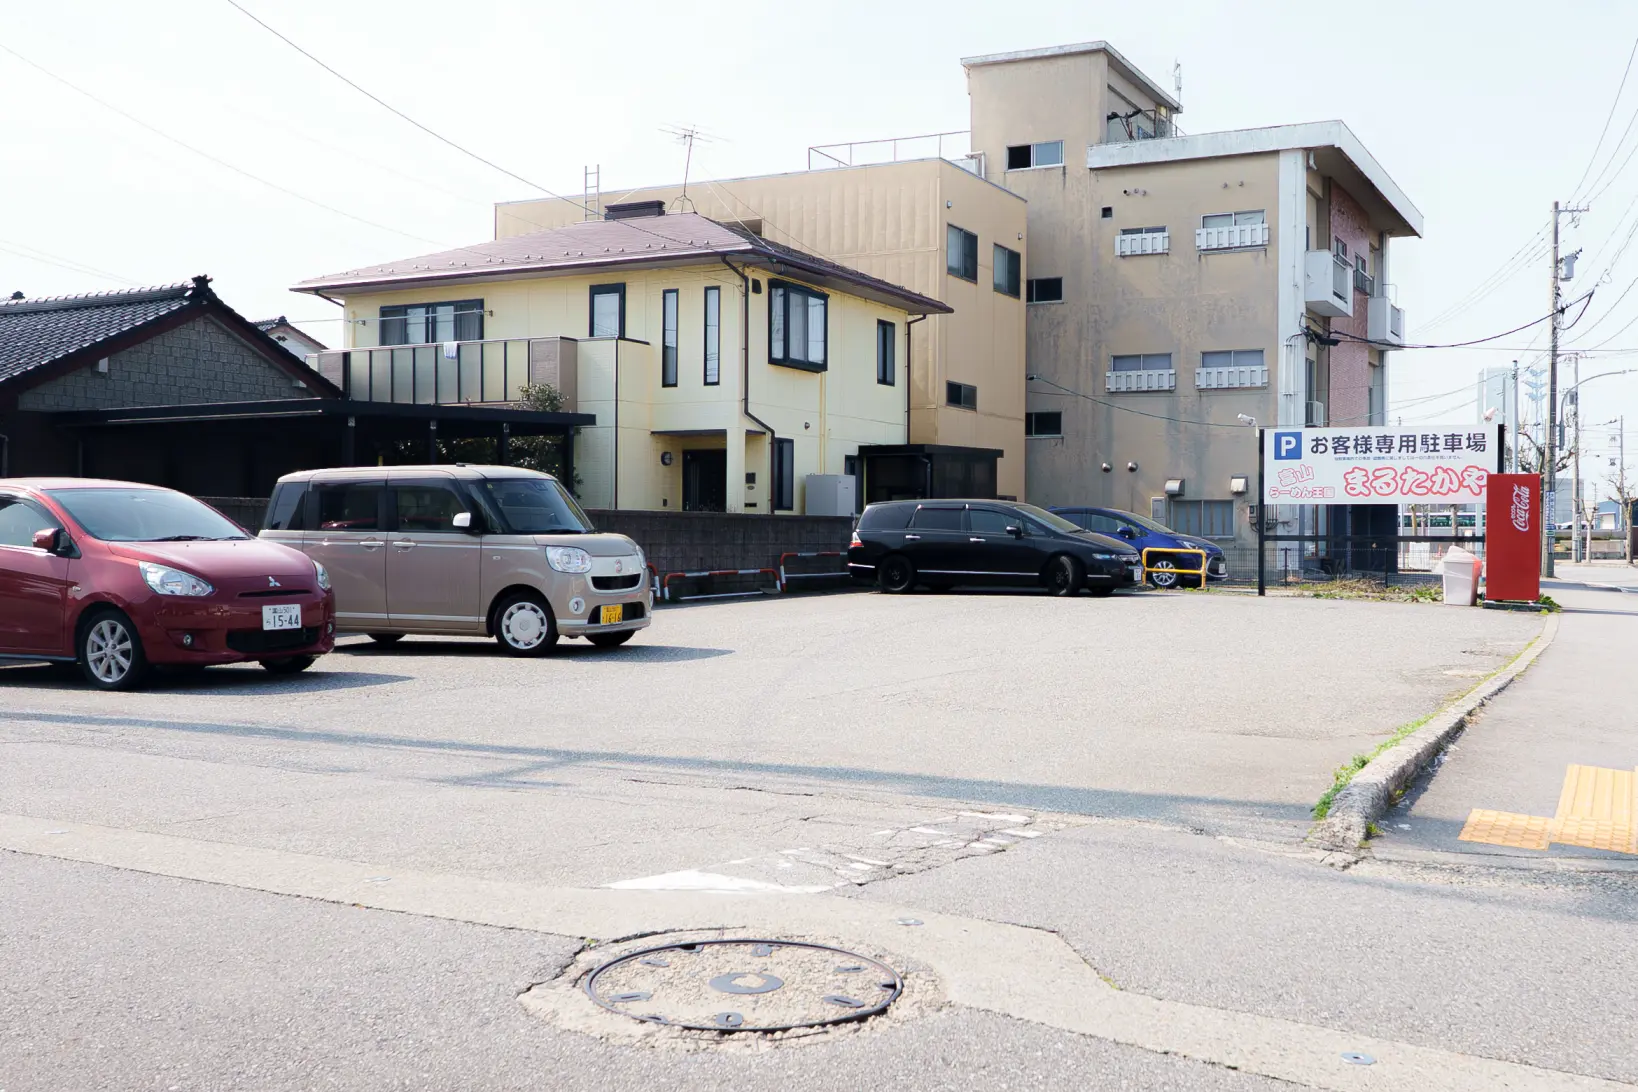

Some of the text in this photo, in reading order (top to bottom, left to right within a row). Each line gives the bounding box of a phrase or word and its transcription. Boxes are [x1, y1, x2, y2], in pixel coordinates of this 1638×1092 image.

[1281, 433, 1486, 456] P お客様専用駐車場
[1278, 464, 1314, 487] 富山
[1343, 465, 1488, 497] まるたかや
[1269, 486, 1335, 498] らーめん王国
[273, 614, 299, 628] 15-44
